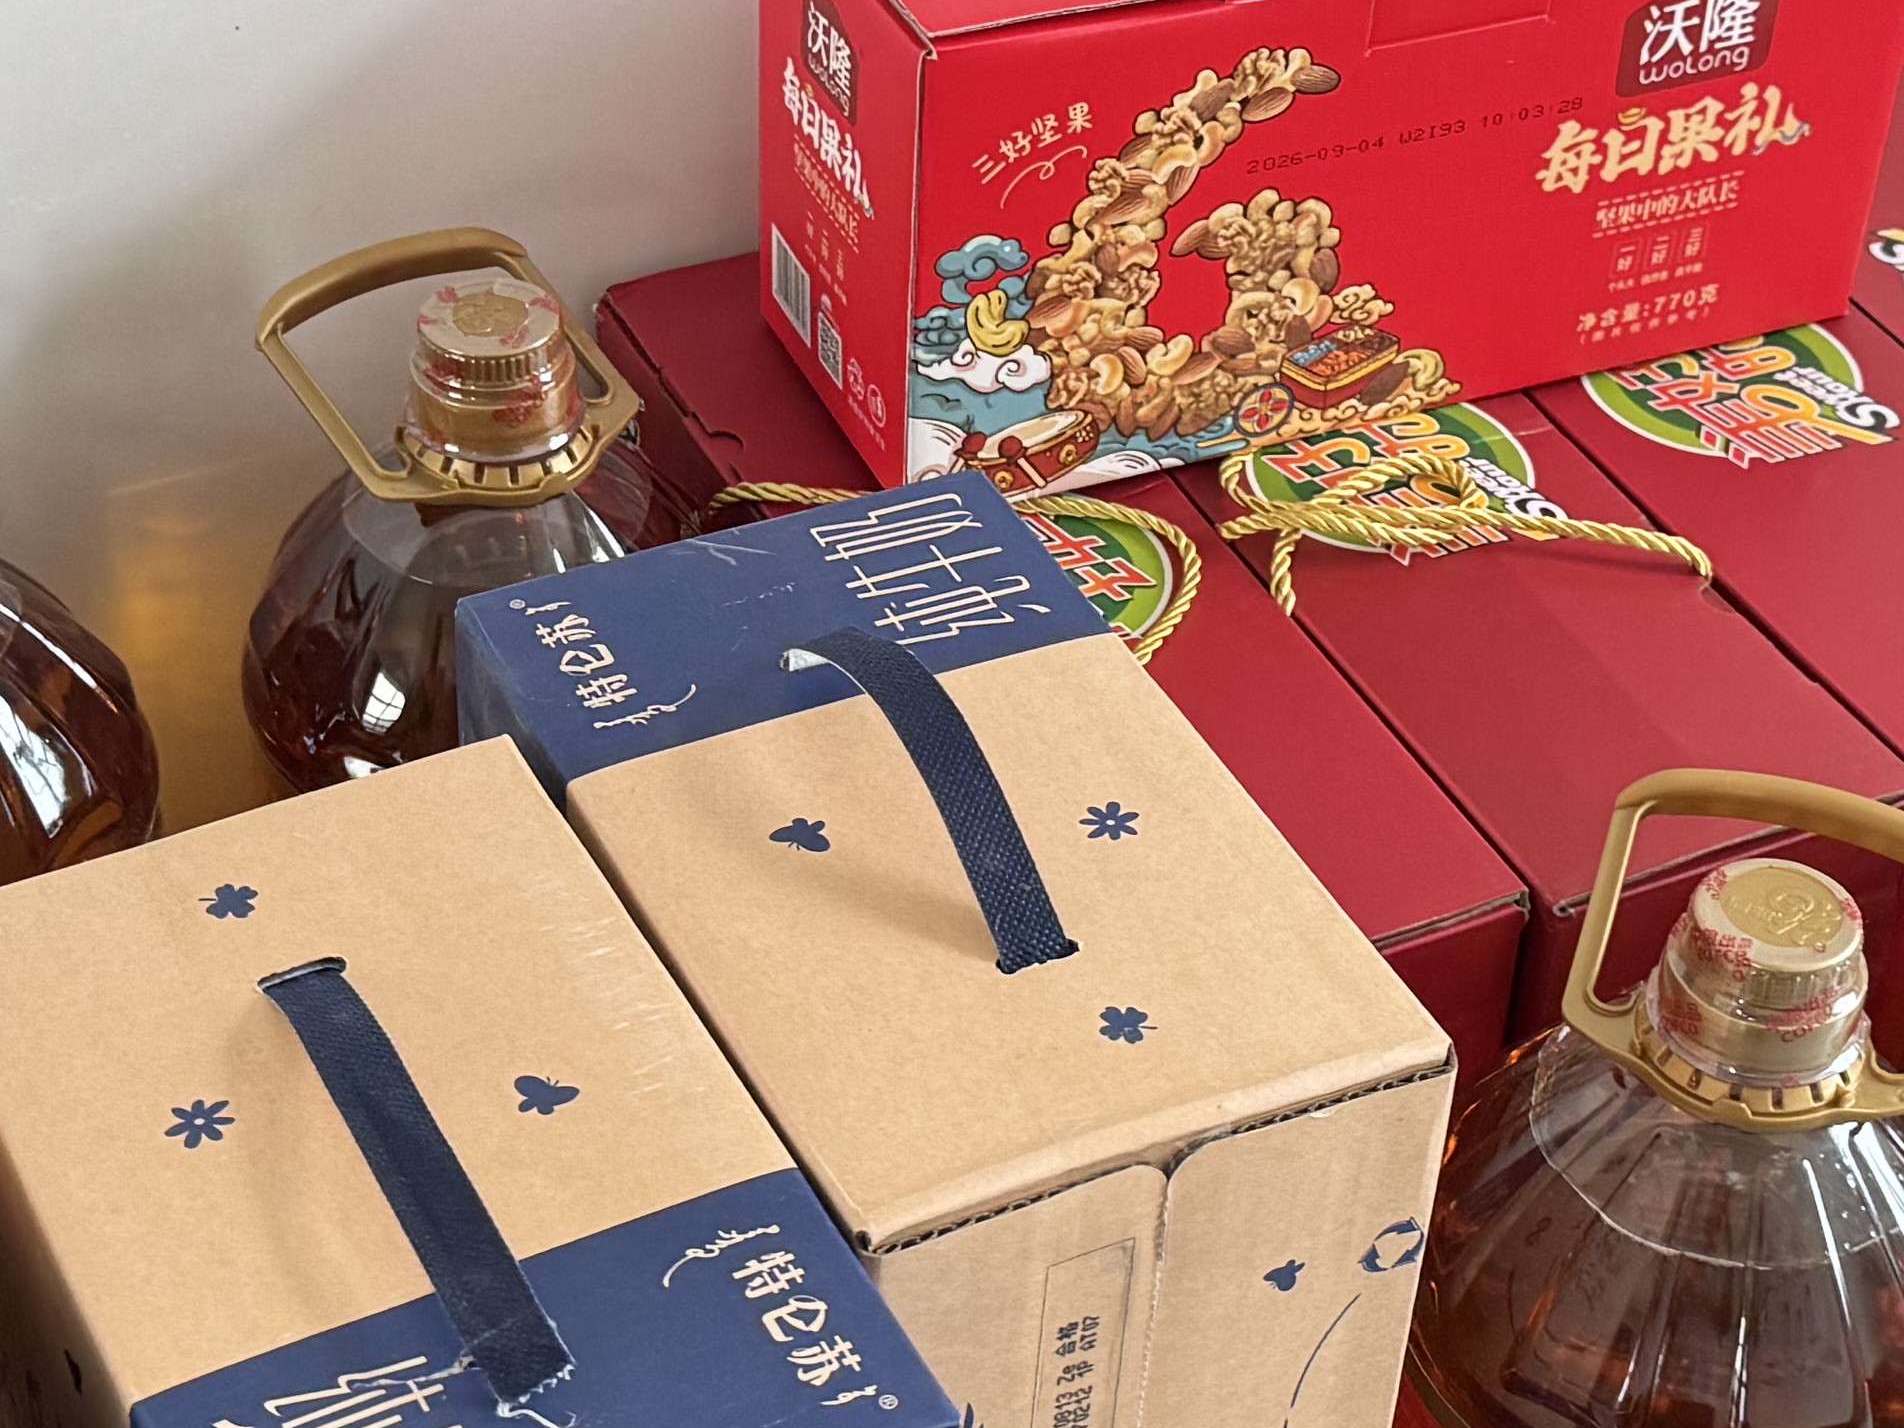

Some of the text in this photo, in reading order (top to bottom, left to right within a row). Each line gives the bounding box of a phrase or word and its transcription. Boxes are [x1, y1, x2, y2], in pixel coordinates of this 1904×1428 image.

[807, 1, 852, 97] 沃隆
[781, 58, 874, 219] 每日果礼
[972, 103, 1093, 185] 三好坚果
[1246, 136, 1385, 175] 2026-09-04
[1535, 82, 1813, 194] 每日果礼
[1596, 180, 1739, 227] 坚果中的大队长
[1576, 284, 1720, 332] 净含量:770克
[535, 612, 638, 709] 特仑苏
[732, 1250, 863, 1388] 特仑苏
[1053, 1319, 1079, 1359] 合格
